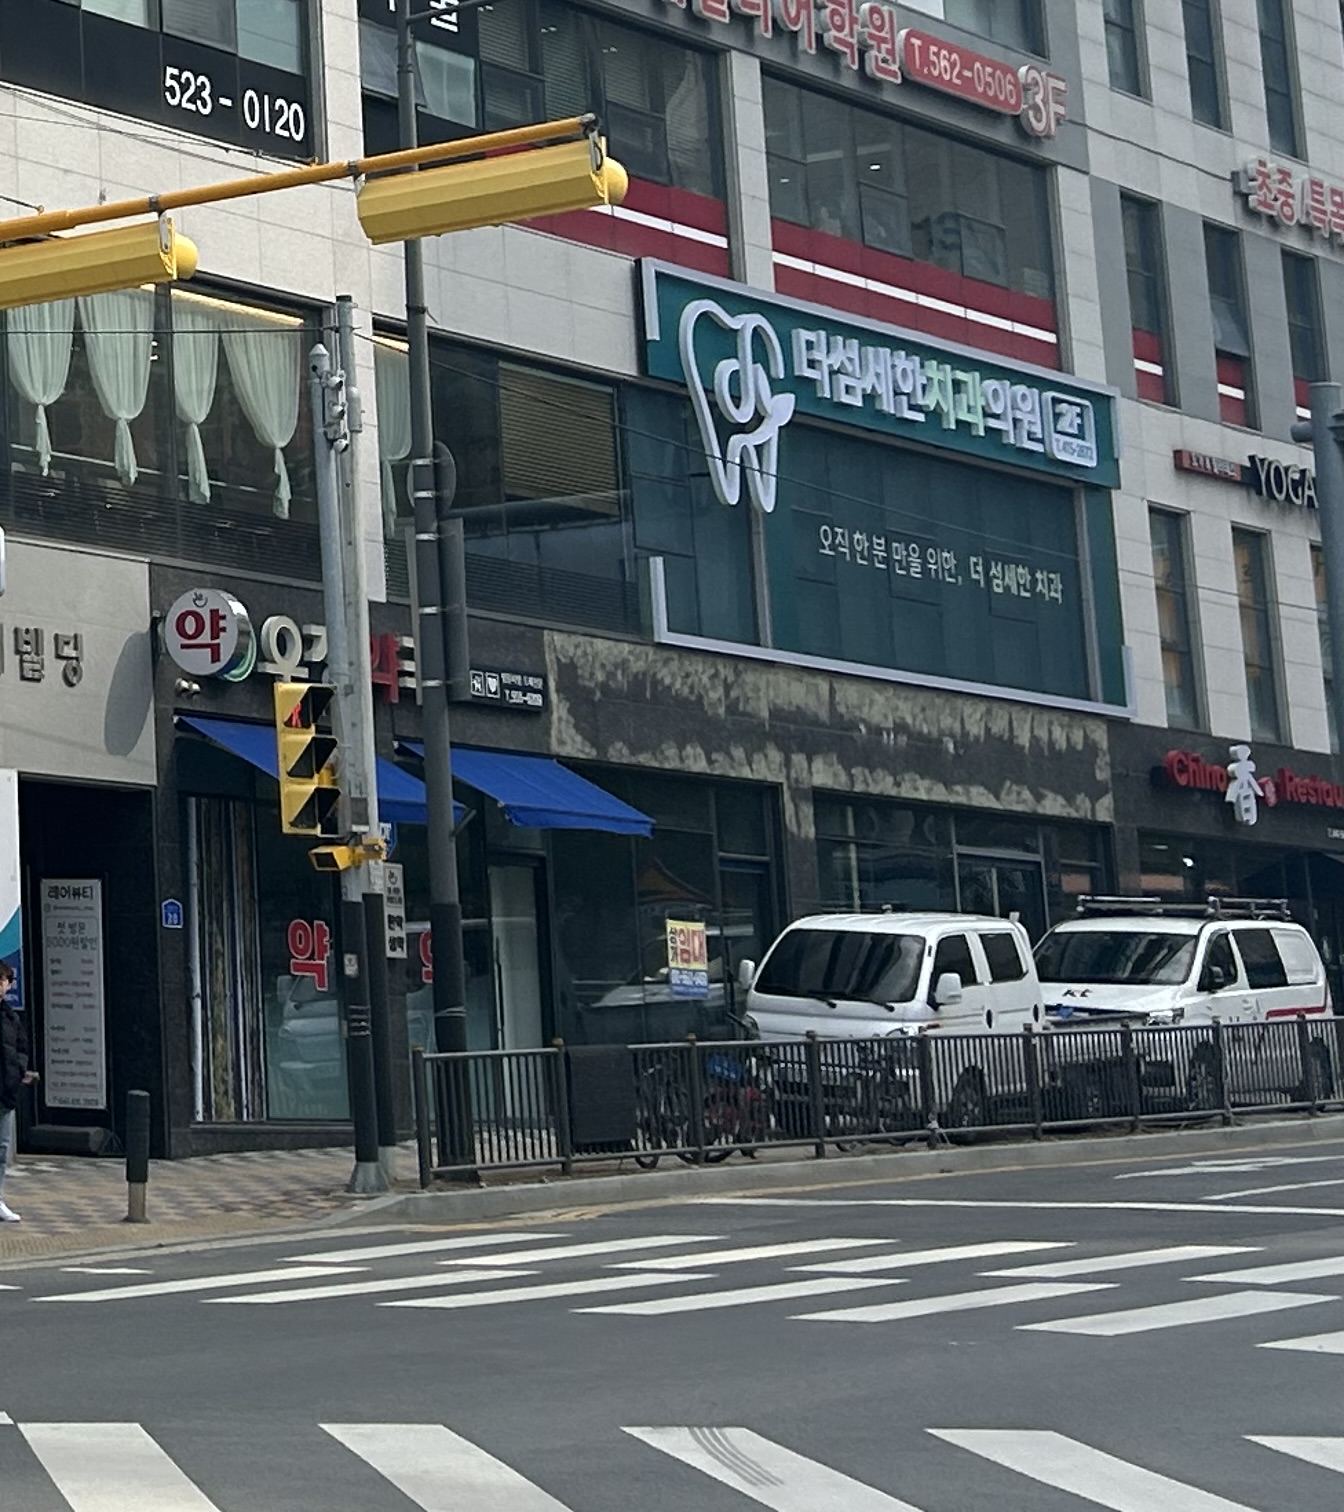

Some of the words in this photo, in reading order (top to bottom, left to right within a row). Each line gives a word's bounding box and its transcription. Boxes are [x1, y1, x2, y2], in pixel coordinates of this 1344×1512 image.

[909, 38, 1018, 107] T.562-0506
[792, 328, 1045, 453] 더섬세한치과의원
[1252, 455, 1319, 508] YOGA
[819, 524, 850, 561] 오직
[853, 532, 888, 569] 한분
[891, 542, 923, 578] 만을
[926, 549, 963, 586] 위한,
[969, 555, 985, 587] 더
[989, 560, 1031, 598] 섬세한
[1035, 571, 1063, 604] 치과
[175, 608, 227, 664] 약
[47, 885, 94, 900] 레어뷰티
[288, 919, 333, 992] 약
